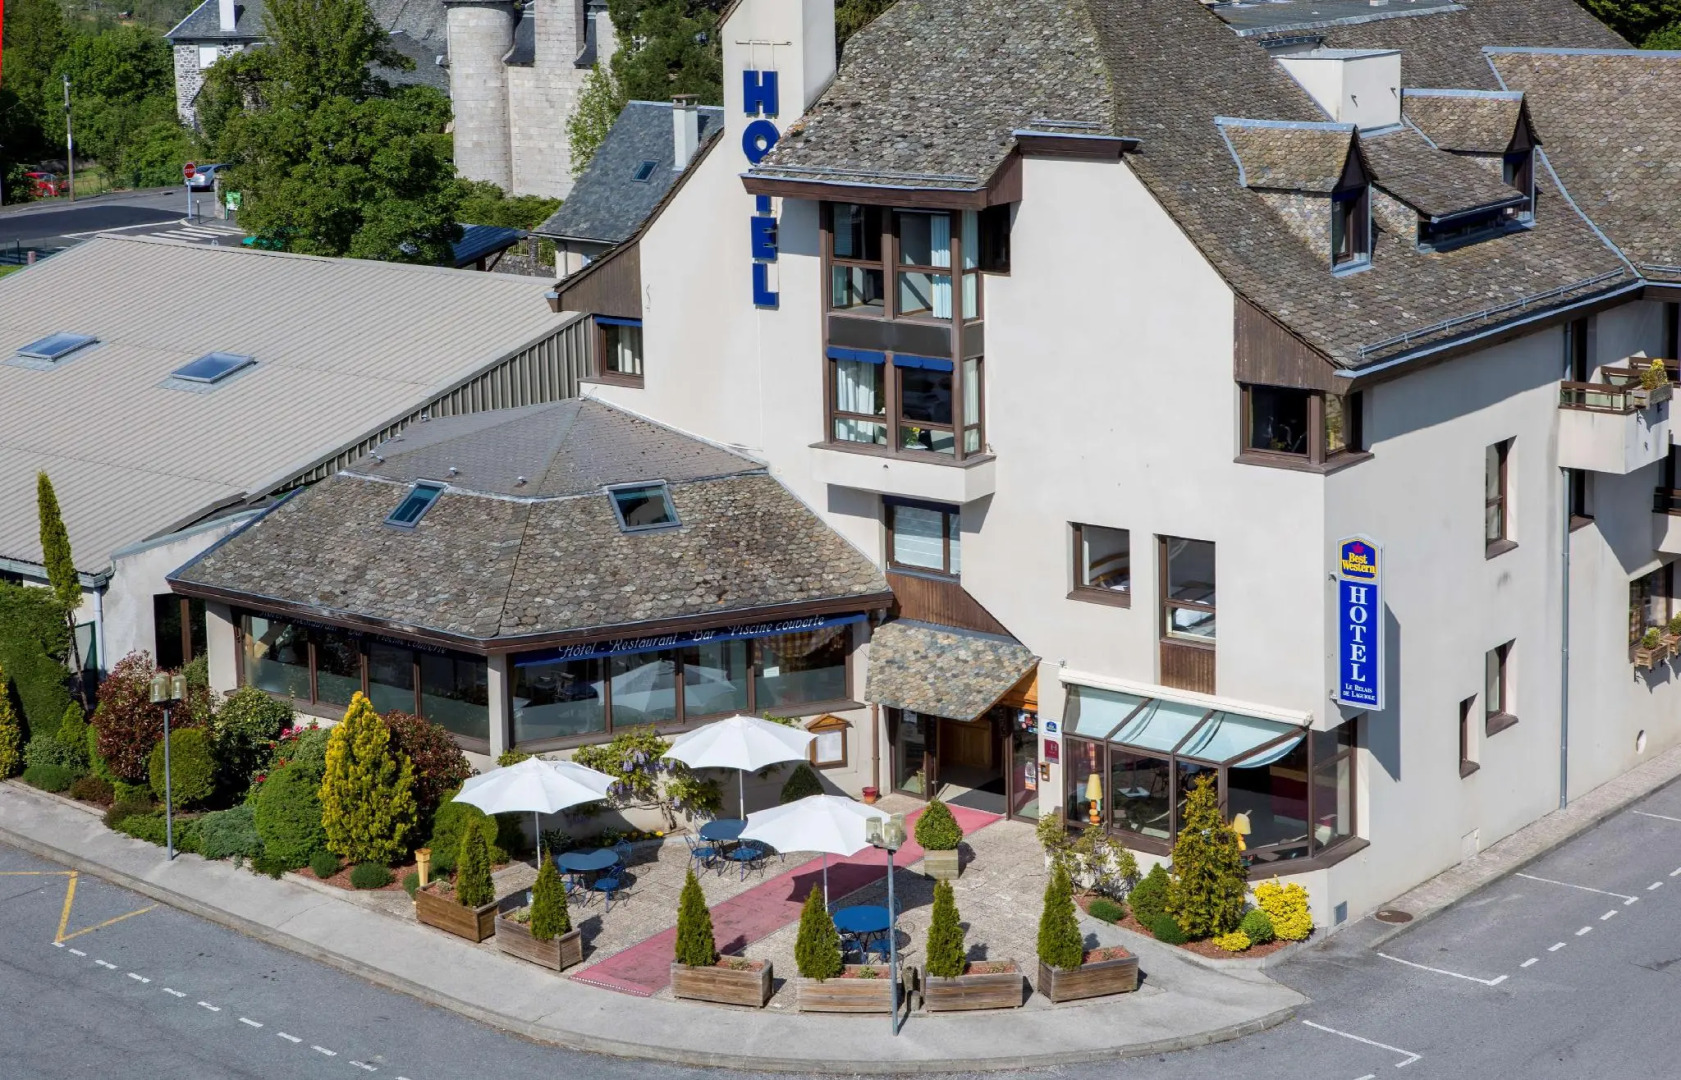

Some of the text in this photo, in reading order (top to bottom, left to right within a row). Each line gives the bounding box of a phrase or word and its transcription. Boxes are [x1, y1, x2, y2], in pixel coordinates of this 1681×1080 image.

[1342, 559, 1376, 574] Western
[1348, 552, 1368, 564] Best
[558, 642, 597, 659] Hôtel
[609, 633, 679, 653] Restaurant
[689, 628, 717, 642] Bar
[727, 621, 773, 637] Piscine
[775, 614, 825, 632] couverte
[1349, 585, 1368, 682] HOTEL
